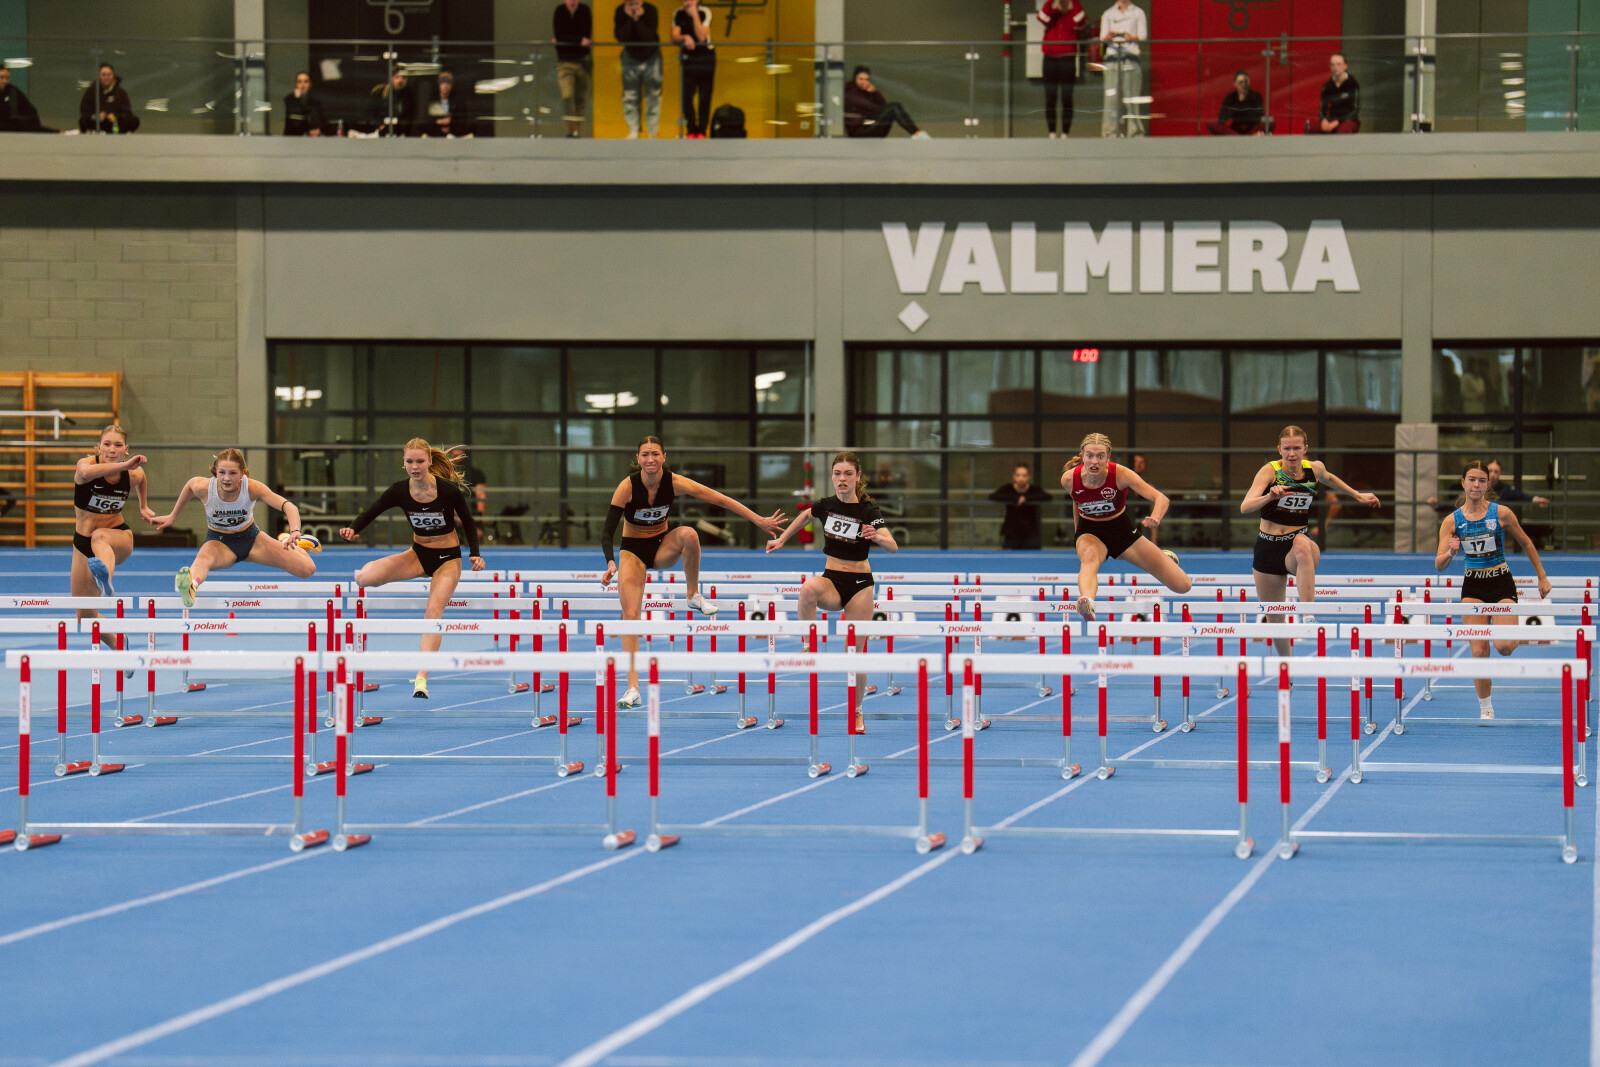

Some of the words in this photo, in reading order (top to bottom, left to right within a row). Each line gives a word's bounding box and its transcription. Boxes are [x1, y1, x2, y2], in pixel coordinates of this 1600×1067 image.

[881, 220, 1361, 294] VALMIERA
[95, 498, 120, 510] 166
[1284, 496, 1308, 507] 513
[412, 518, 442, 526] 260
[831, 520, 852, 534] 87
[1275, 532, 1296, 542] PRO
[1470, 540, 1486, 552] 17
[1474, 568, 1500, 579] NIKE
[254, 583, 280, 592] polanik
[781, 586, 802, 594] polan
[957, 587, 983, 595] polanik
[1134, 588, 1160, 596] polanik
[20, 598, 50, 607] polanik
[231, 599, 261, 608] polanik
[445, 599, 468, 608] olanik
[644, 600, 674, 609] polanik
[1267, 603, 1297, 613] polanik
[1481, 604, 1512, 614] polanik
[193, 621, 228, 632] polanik
[446, 623, 480, 633] polanik
[695, 624, 730, 633] polanik
[947, 625, 983, 634] polanik
[1200, 626, 1236, 636] polanik
[1456, 627, 1492, 638] polanik
[149, 656, 193, 668] polanik
[463, 657, 505, 668] polanik
[1091, 660, 1135, 672] polanik
[1410, 662, 1455, 674] polanik
